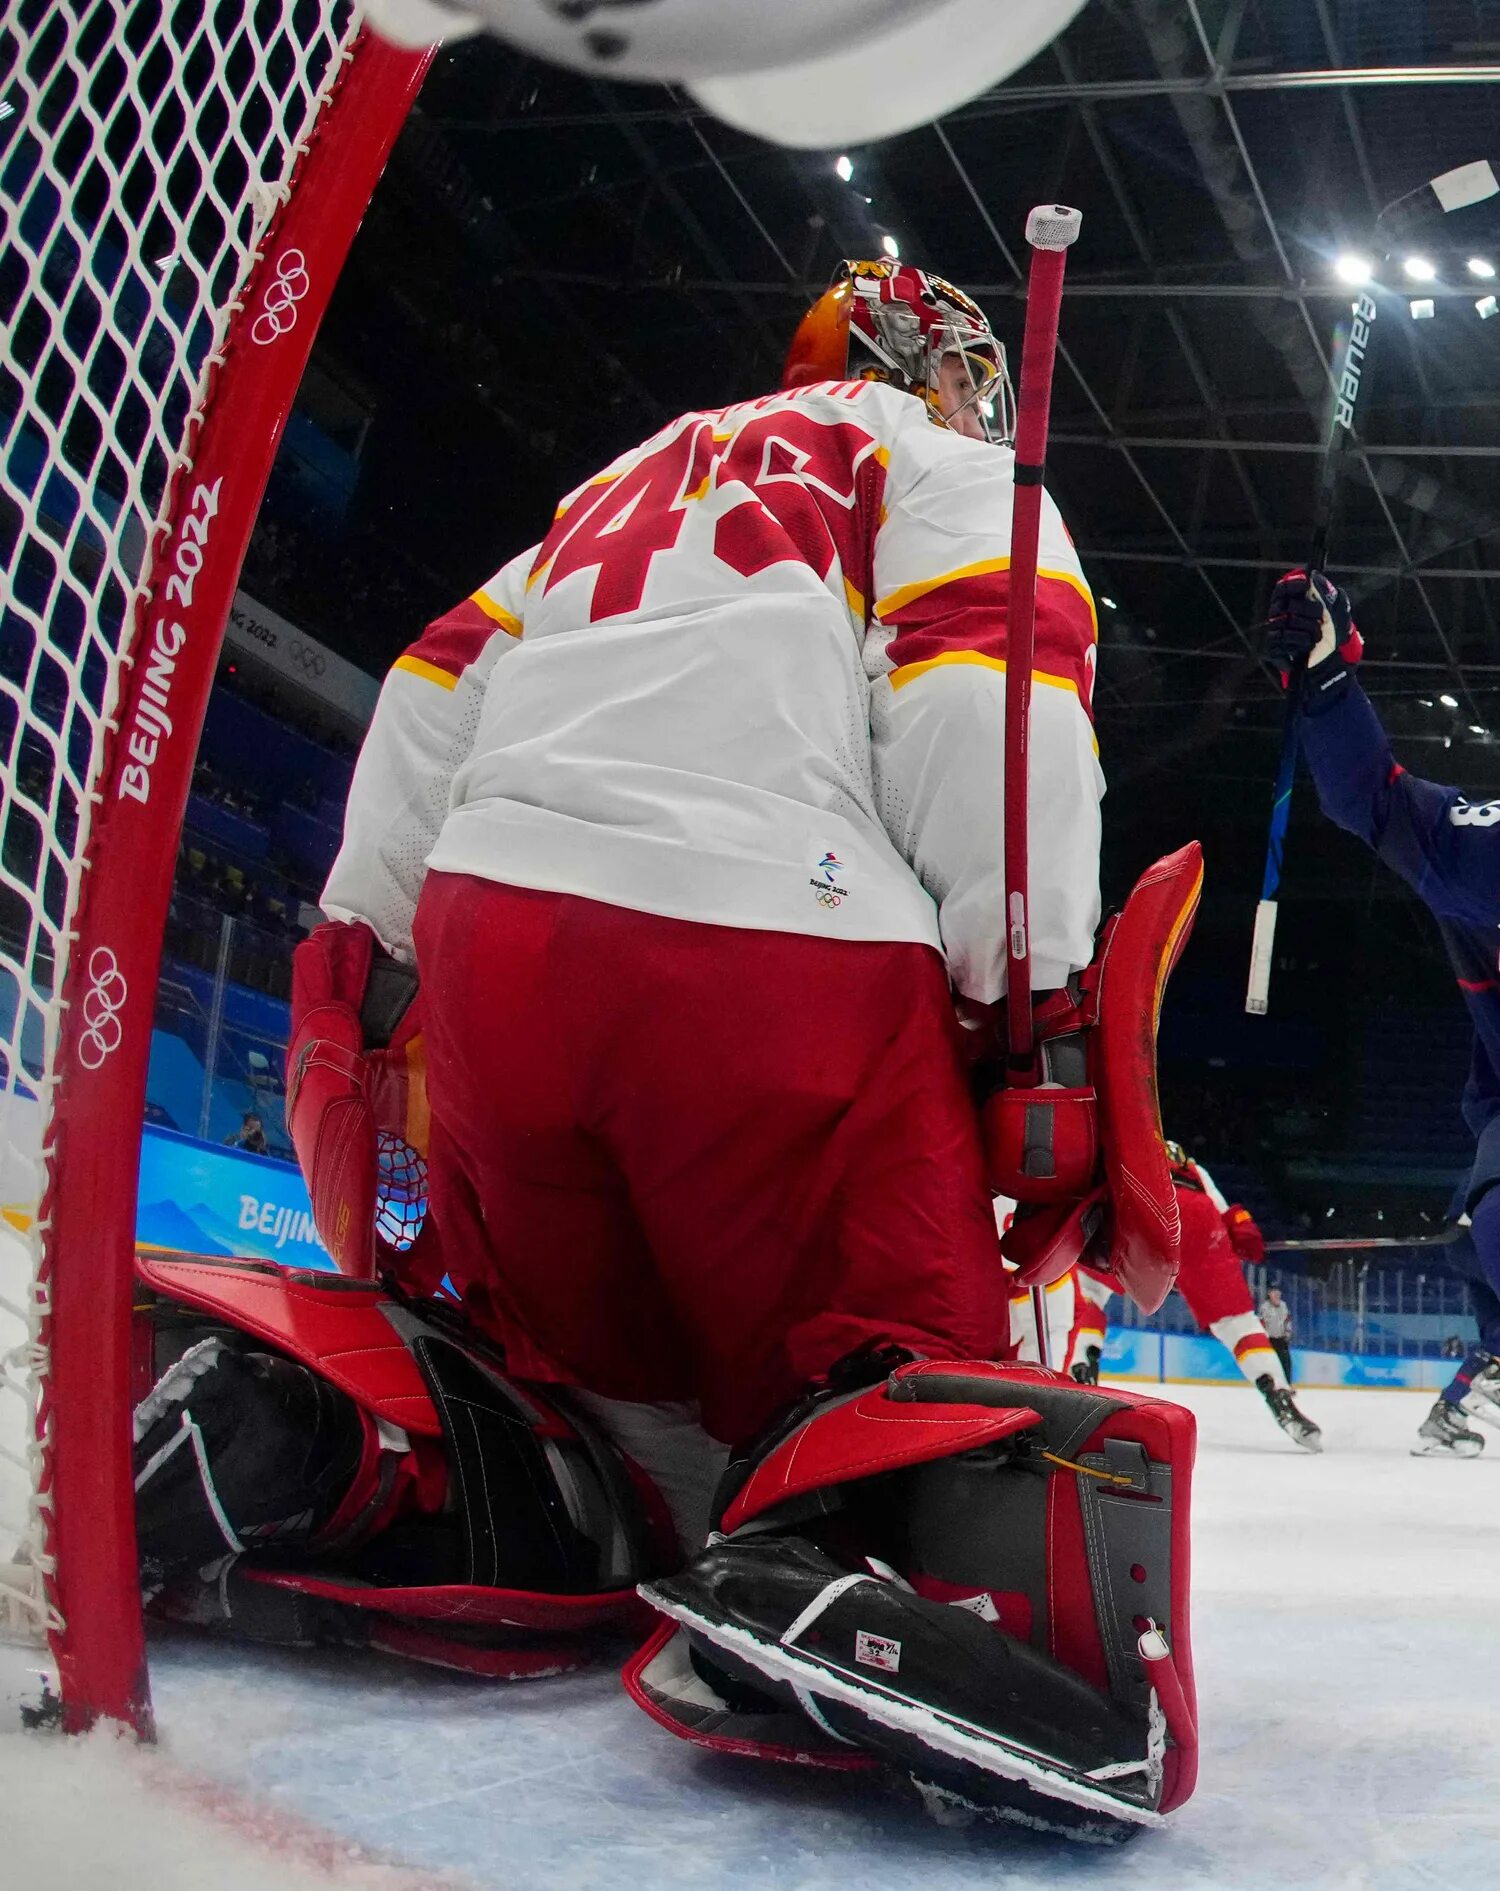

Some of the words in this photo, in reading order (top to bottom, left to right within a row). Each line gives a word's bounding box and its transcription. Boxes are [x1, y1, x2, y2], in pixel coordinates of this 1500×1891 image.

[1334, 292, 1376, 429] BAUER
[118, 618, 187, 805] BEIJING
[166, 475, 224, 608] 2022
[238, 1194, 323, 1250] BEIJIN
